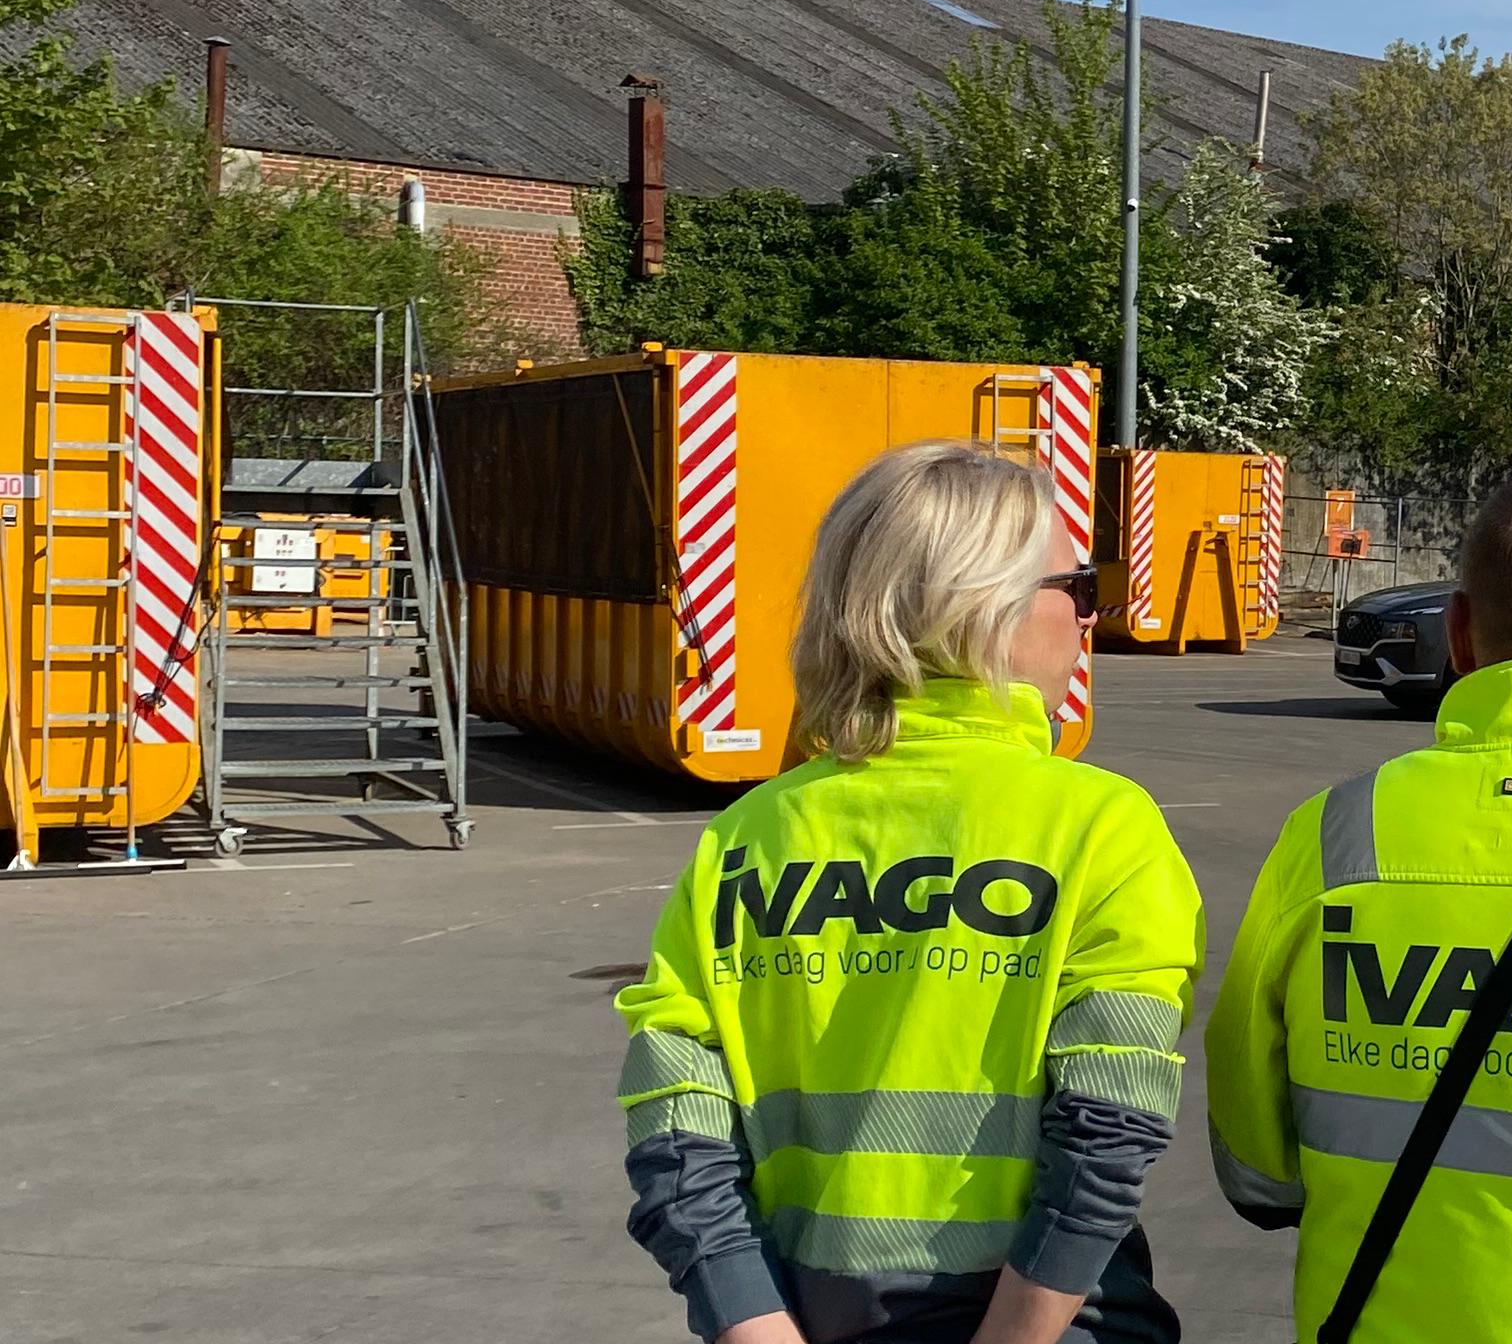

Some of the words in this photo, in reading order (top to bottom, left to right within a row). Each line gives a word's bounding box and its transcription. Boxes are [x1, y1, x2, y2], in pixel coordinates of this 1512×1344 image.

[713, 951, 767, 985] Elke
[774, 944, 825, 984] dag
[838, 948, 905, 975] voor
[927, 945, 969, 981] op
[979, 947, 1042, 983] pad.
[1324, 1030, 1381, 1067] Elke
